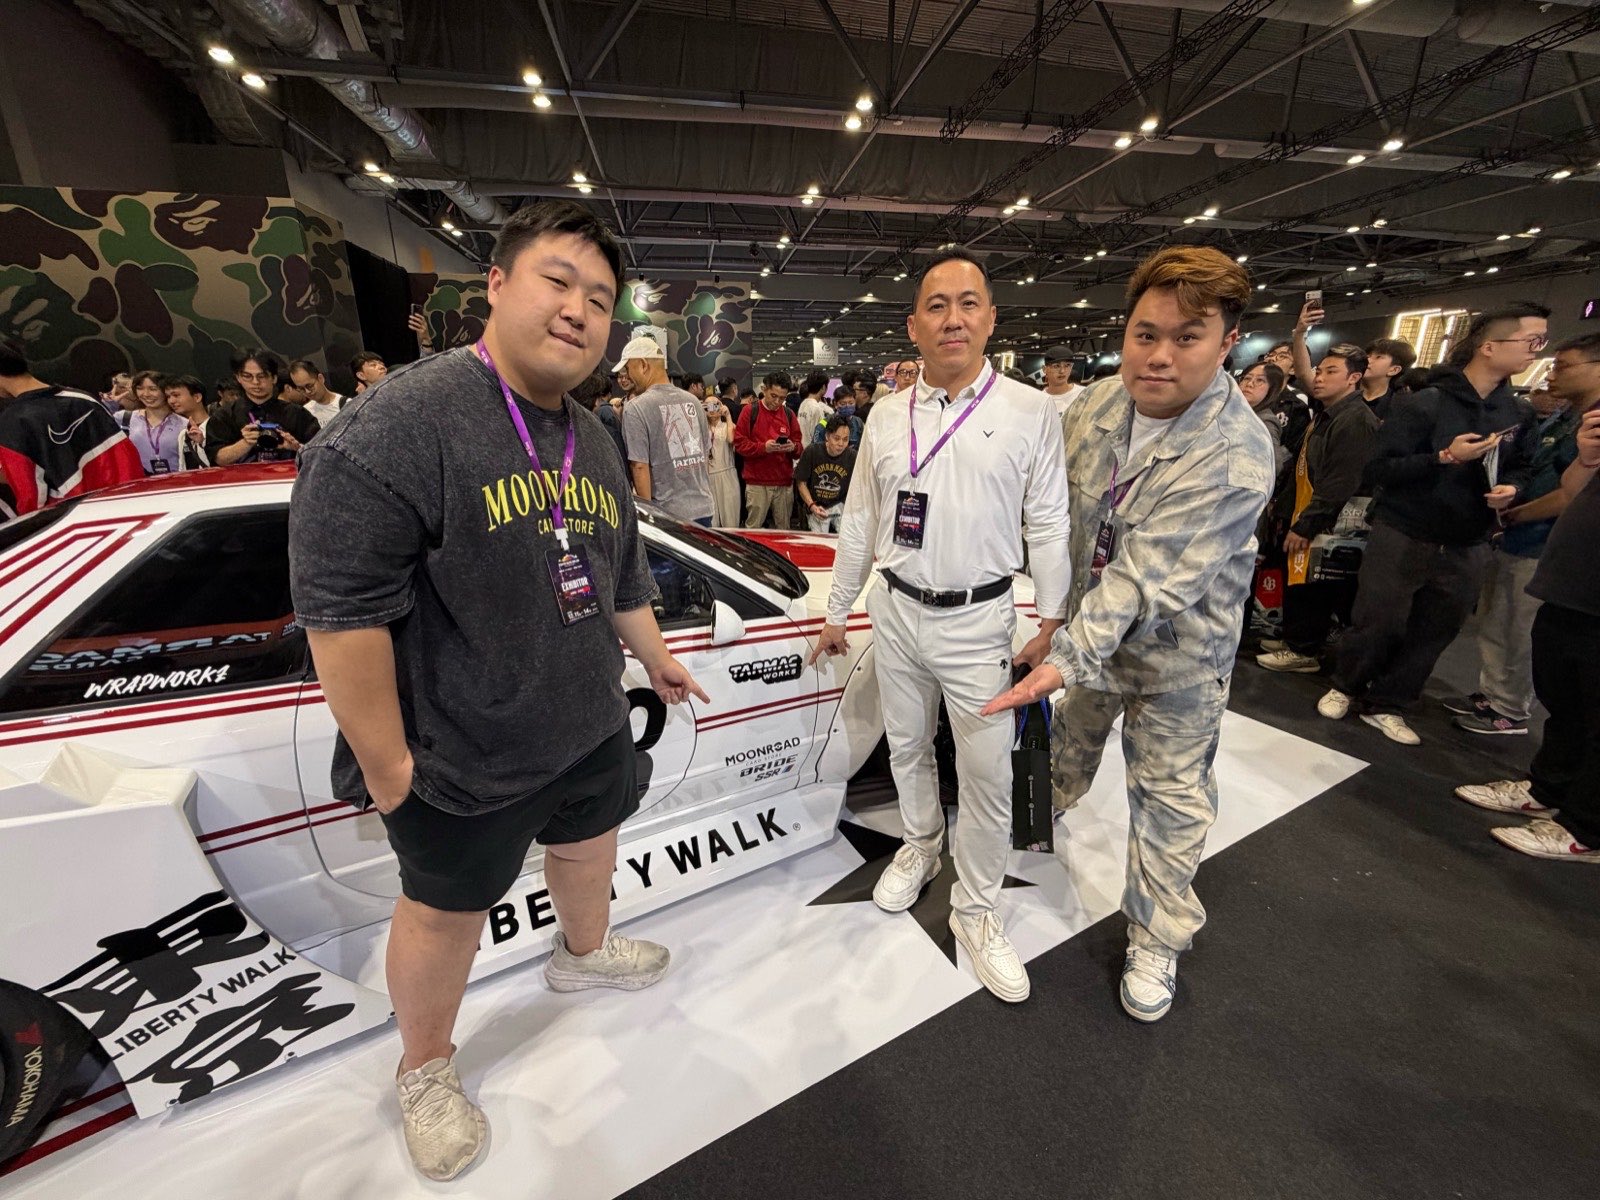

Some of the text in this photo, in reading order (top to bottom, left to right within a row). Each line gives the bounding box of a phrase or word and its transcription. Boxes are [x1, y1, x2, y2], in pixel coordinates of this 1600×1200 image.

[482, 470, 619, 532] MOONROAD
[83, 664, 231, 699] WRAPWORKZ
[729, 655, 799, 680] TARMAC
[762, 668, 797, 680] WORKS
[725, 736, 801, 767] MOONROAD
[740, 753, 799, 778] BRIDE
[754, 767, 782, 782] SSR
[664, 807, 788, 875] WALK
[218, 946, 297, 994] WALK
[5, 1045, 43, 1128] YOKOHAMA
